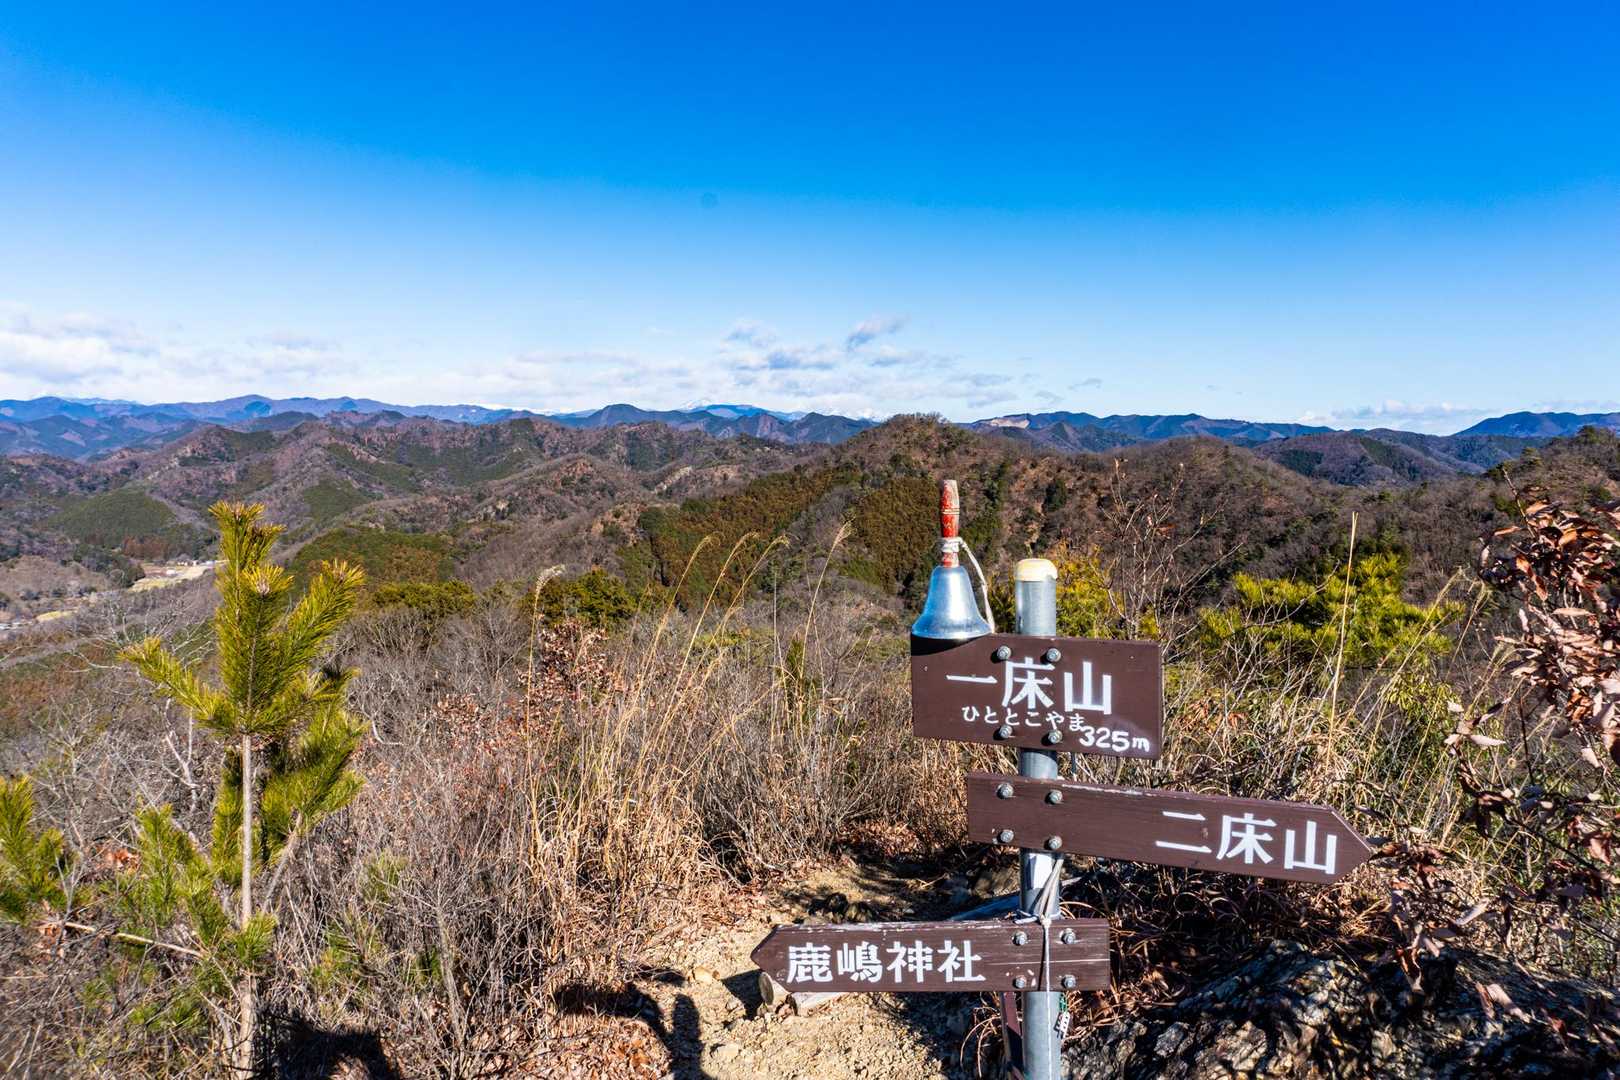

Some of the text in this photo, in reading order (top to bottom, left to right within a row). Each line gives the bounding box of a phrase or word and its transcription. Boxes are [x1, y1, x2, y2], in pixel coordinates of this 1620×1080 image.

[946, 657, 1112, 715] 一床山
[962, 705, 1086, 732] ひととこやま
[1079, 726, 1150, 752] 325m
[1155, 811, 1337, 875] 二床山
[786, 940, 986, 984] 鹿嶋神社
